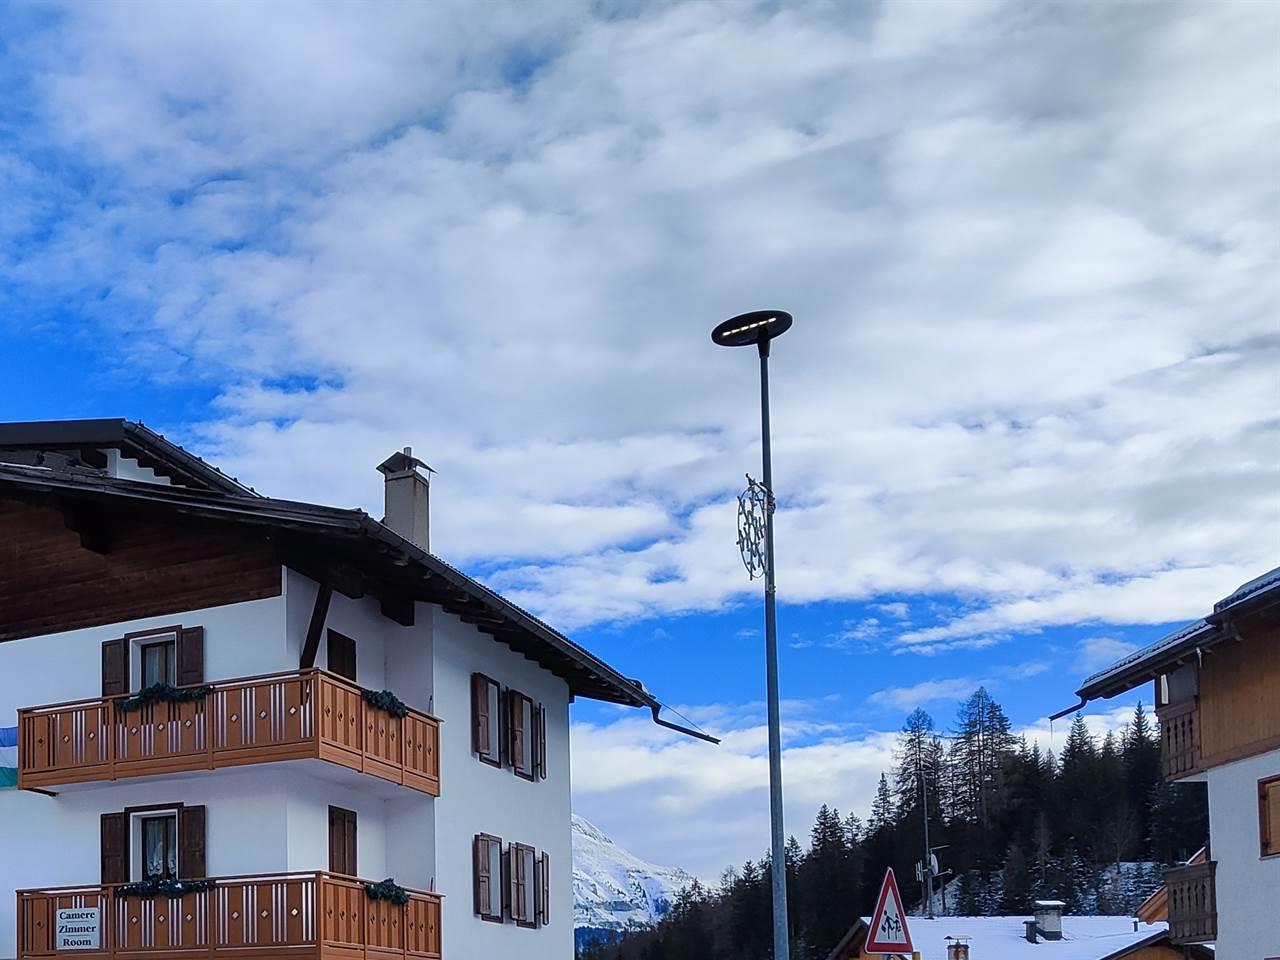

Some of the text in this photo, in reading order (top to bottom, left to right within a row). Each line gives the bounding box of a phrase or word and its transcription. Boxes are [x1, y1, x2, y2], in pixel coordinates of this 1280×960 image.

[59, 911, 96, 920] Camere
[58, 924, 97, 934] Zimmer
[63, 938, 92, 947] Room
